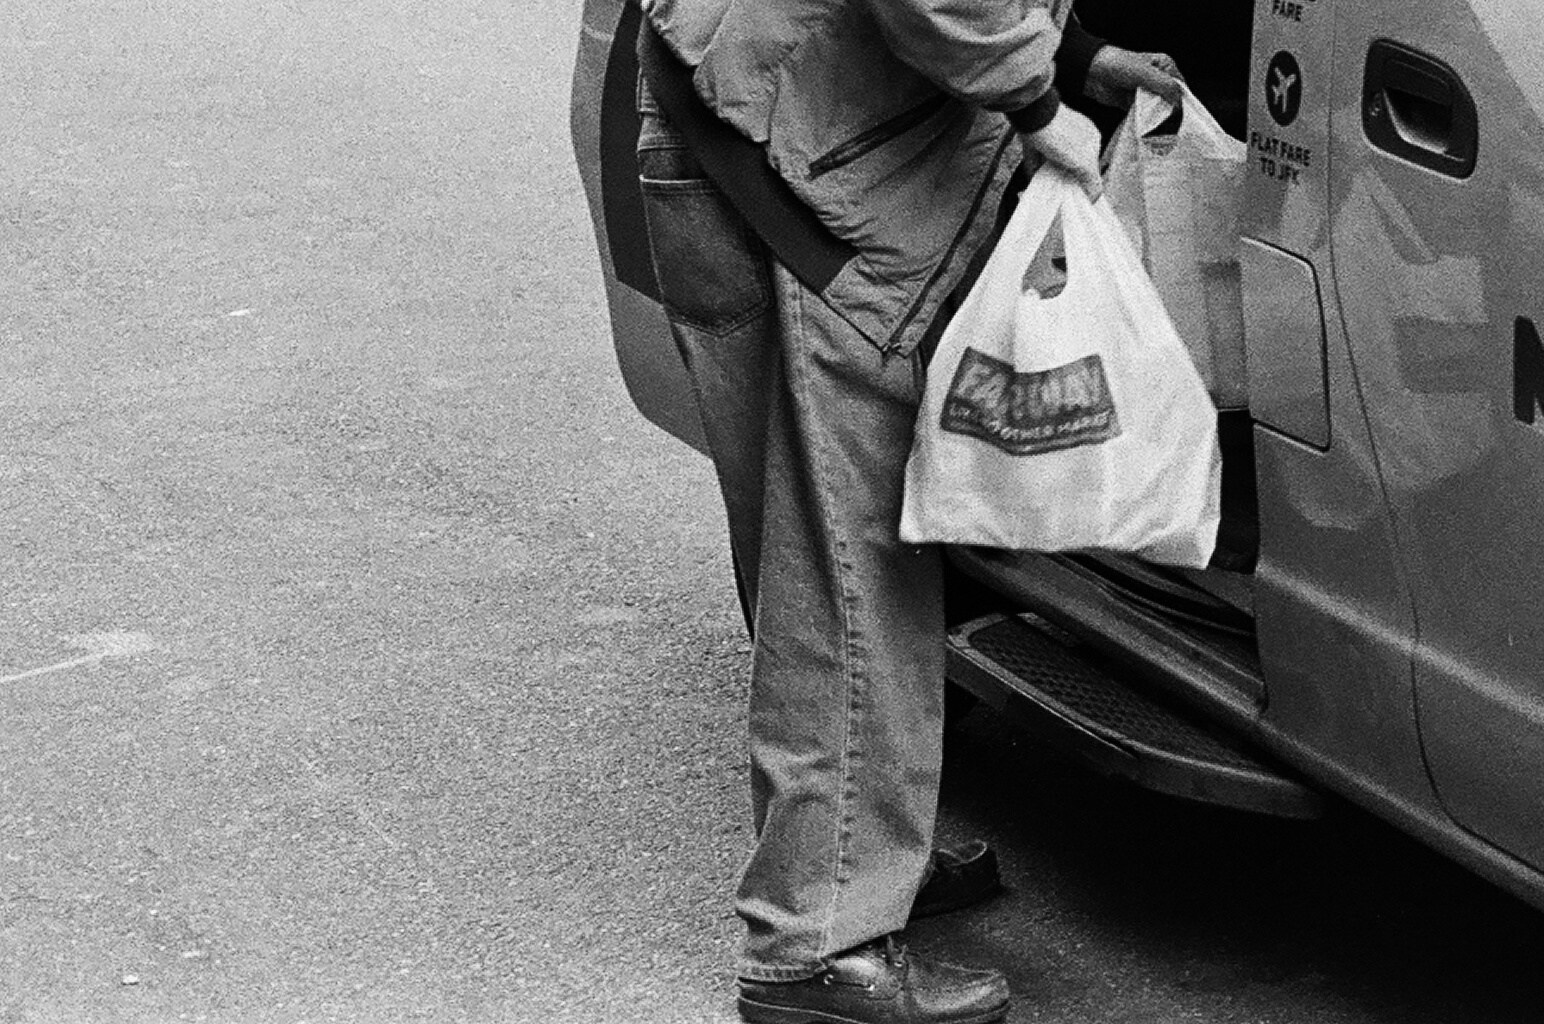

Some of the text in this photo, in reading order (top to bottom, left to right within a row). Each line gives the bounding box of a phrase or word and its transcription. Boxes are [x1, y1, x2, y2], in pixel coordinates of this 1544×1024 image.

[1272, 0, 1303, 22] FARE
[1251, 131, 1311, 167] FLAT FARE
[1260, 157, 1276, 177] TO
